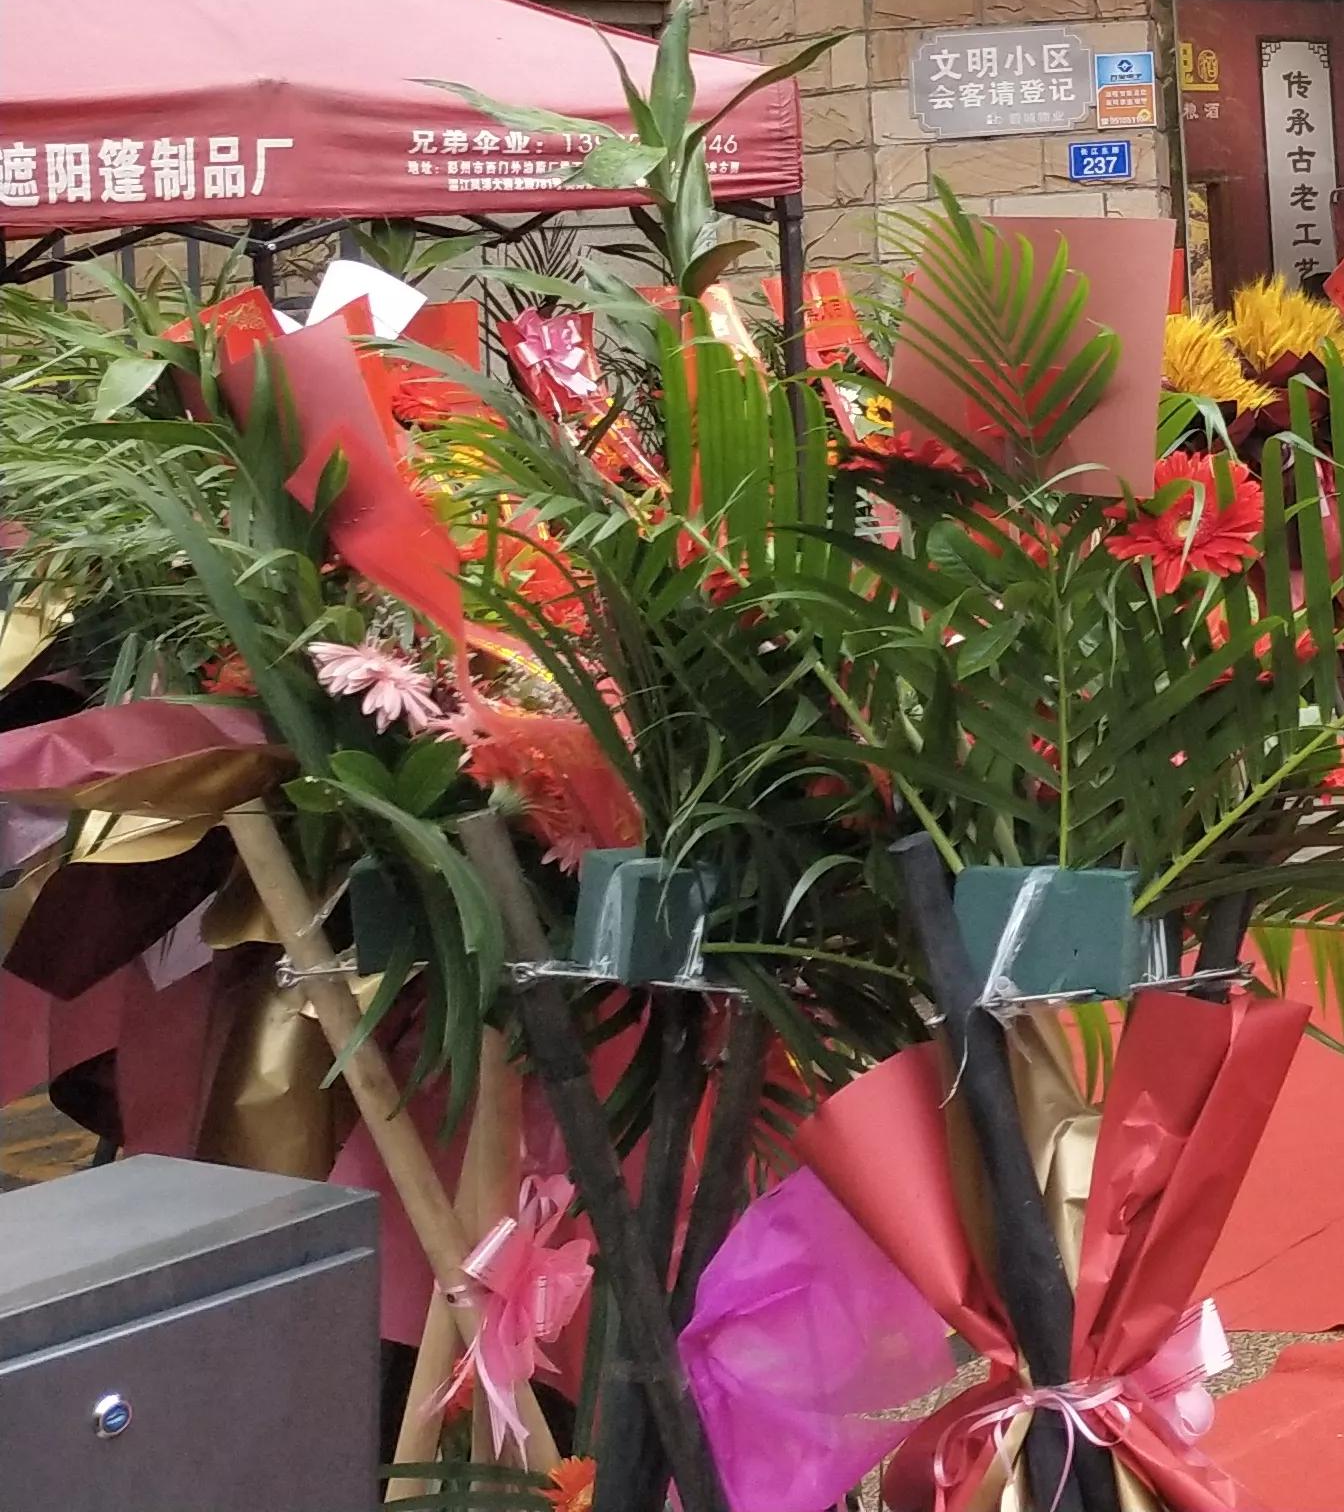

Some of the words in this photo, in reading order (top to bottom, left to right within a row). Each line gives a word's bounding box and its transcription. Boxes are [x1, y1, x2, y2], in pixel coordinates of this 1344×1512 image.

[930, 43, 1074, 81] 文明小区
[928, 78, 1076, 111] 会客请登记
[1083, 156, 1118, 175] 237
[1282, 70, 1322, 279] 传承古老工艺
